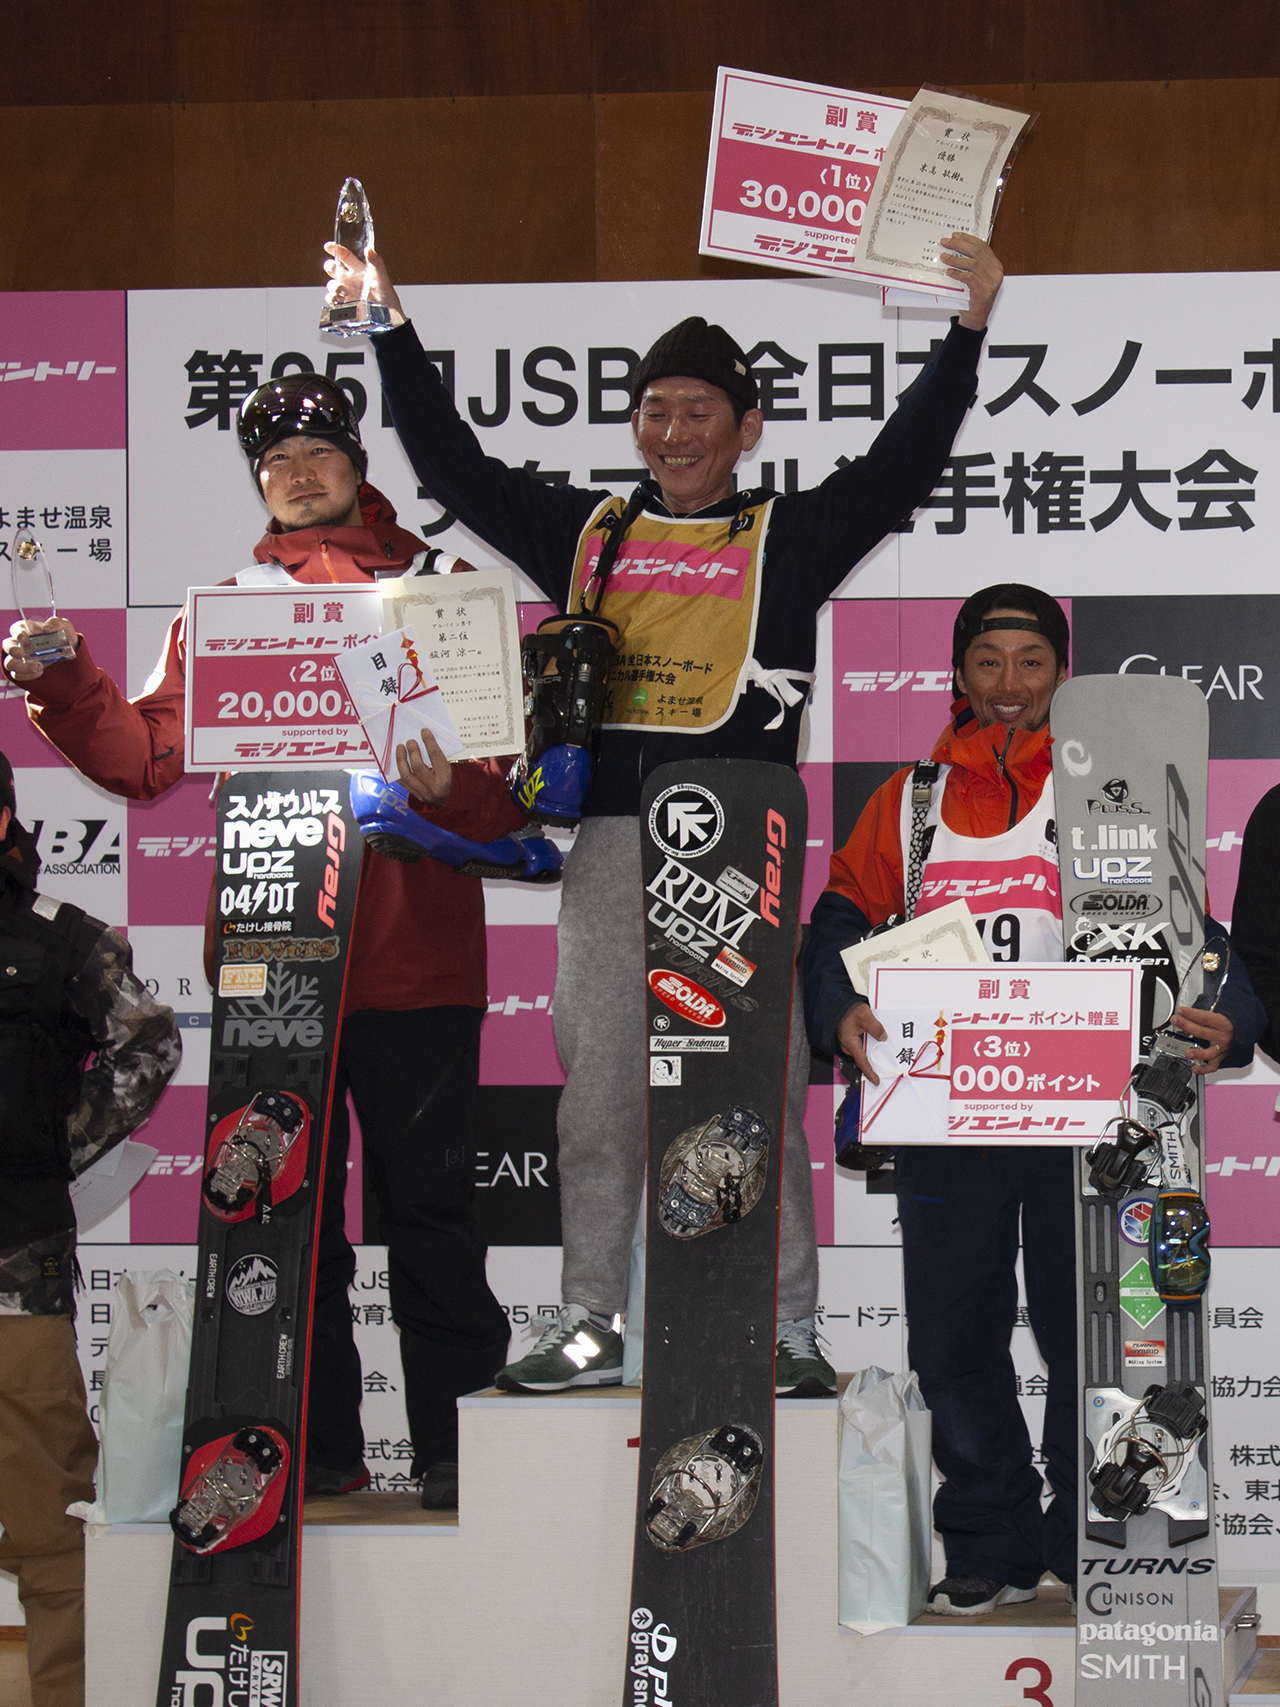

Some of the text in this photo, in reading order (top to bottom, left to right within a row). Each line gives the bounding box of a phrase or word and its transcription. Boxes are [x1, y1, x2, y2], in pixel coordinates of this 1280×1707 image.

[825, 105, 878, 134] 副賞
[732, 122, 870, 156] デジエントリー
[739, 179, 868, 227] 30,000
[804, 229, 858, 245] supported
[0, 360, 117, 382] ントリー
[293, 602, 344, 624] 副賞
[435, 606, 467, 620] 賞状
[204, 635, 338, 651] デジエントリー
[438, 631, 469, 643] 第二位
[217, 690, 342, 722] 20,000
[282, 727, 349, 739] supported by
[225, 788, 343, 820] スノサウルス
[223, 816, 324, 850] neve
[44, 863, 121, 876] ASSOCIATION
[317, 811, 346, 930] Gray
[759, 807, 787, 929] Gray
[1108, 877, 1153, 885] hardboots
[918, 873, 1057, 899] ジエントリー
[645, 854, 762, 950] RPM
[235, 920, 292, 934] たけし接骨院
[668, 936, 705, 964] hardboots
[722, 955, 747, 974] HYBRID
[978, 978, 1031, 1000] 副賞
[1028, 1010, 1120, 1027] ポイント贈呈
[222, 1019, 324, 1048] neve
[964, 1102, 1034, 1112] supported by
[1165, 1131, 1181, 1181] SMITH
[276, 1356, 287, 1379] EARTH
[1081, 1557, 1216, 1576] TURNS
[1079, 1620, 1219, 1646] patagonia
[251, 1655, 260, 1699] CARVE
[1080, 1653, 1187, 1680] SMITH
[1004, 1657, 1055, 1707] 3
